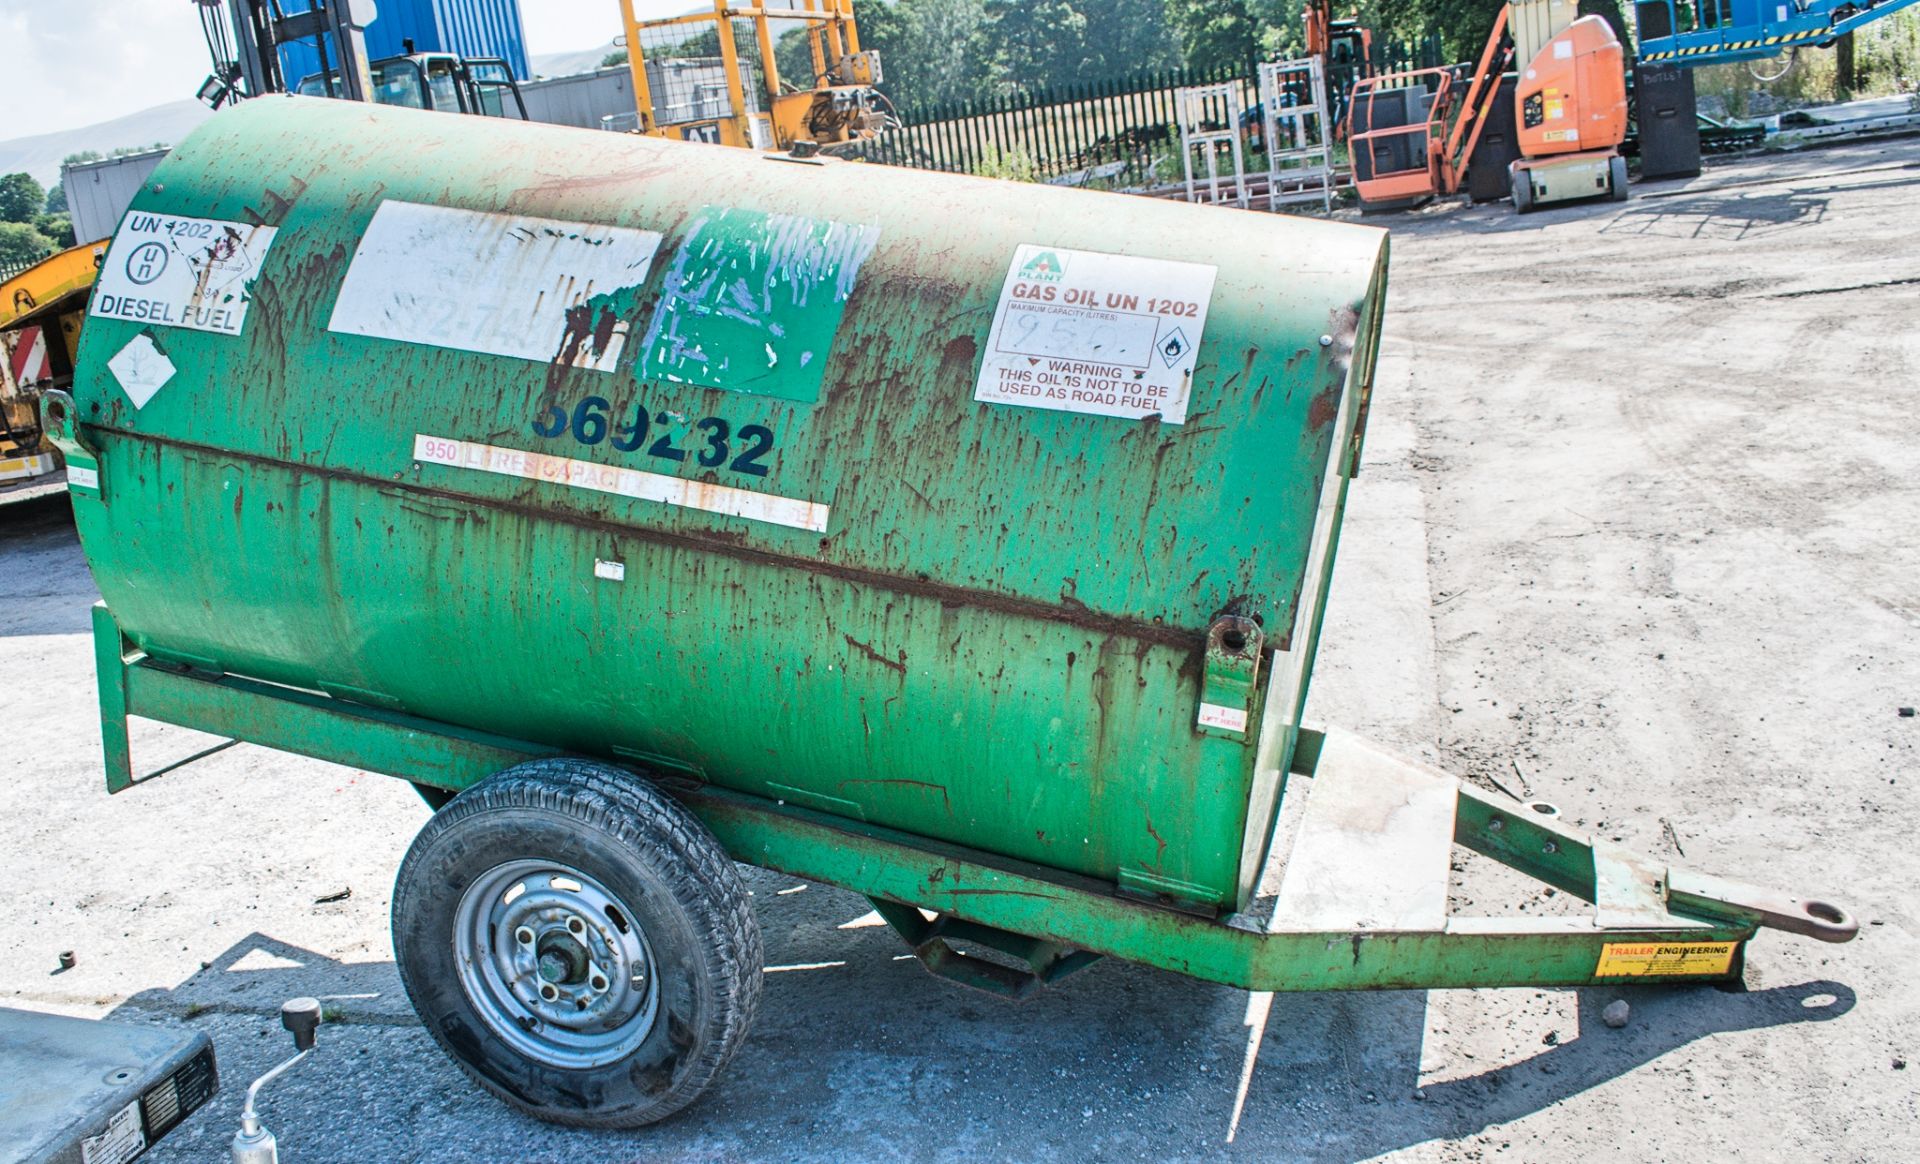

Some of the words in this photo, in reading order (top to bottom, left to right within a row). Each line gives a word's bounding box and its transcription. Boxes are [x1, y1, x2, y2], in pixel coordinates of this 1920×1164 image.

[130, 215, 162, 233] UN
[165, 219, 213, 240] 1202
[1017, 271, 1063, 282] PLANT
[1012, 283, 1057, 302] GAS
[1063, 287, 1099, 307] OIL
[1106, 293, 1139, 311] UN
[1146, 298, 1199, 317] 1202
[100, 295, 173, 322] DIESEL
[181, 305, 235, 331] FUEL
[1010, 303, 1046, 313] MAXIMUM
[1047, 307, 1084, 318] CAPACITY
[1086, 312, 1118, 321] (LITRES)
[1049, 360, 1122, 379] WARNING
[999, 368, 1032, 382] THIS
[1037, 373, 1063, 386] OIL
[1064, 376, 1081, 388] IS
[1086, 379, 1118, 392] NOT
[1122, 383, 1142, 396] TO
[1147, 385, 1168, 398] BE
[999, 382, 1042, 397] USED
[1045, 387, 1067, 399] AS
[1072, 391, 1116, 405] ROAD
[1120, 396, 1162, 410] FUEL
[425, 441, 457, 461] 950
[1608, 947, 1654, 956] TRAILER
[1656, 946, 1729, 955] ENGINEERING
